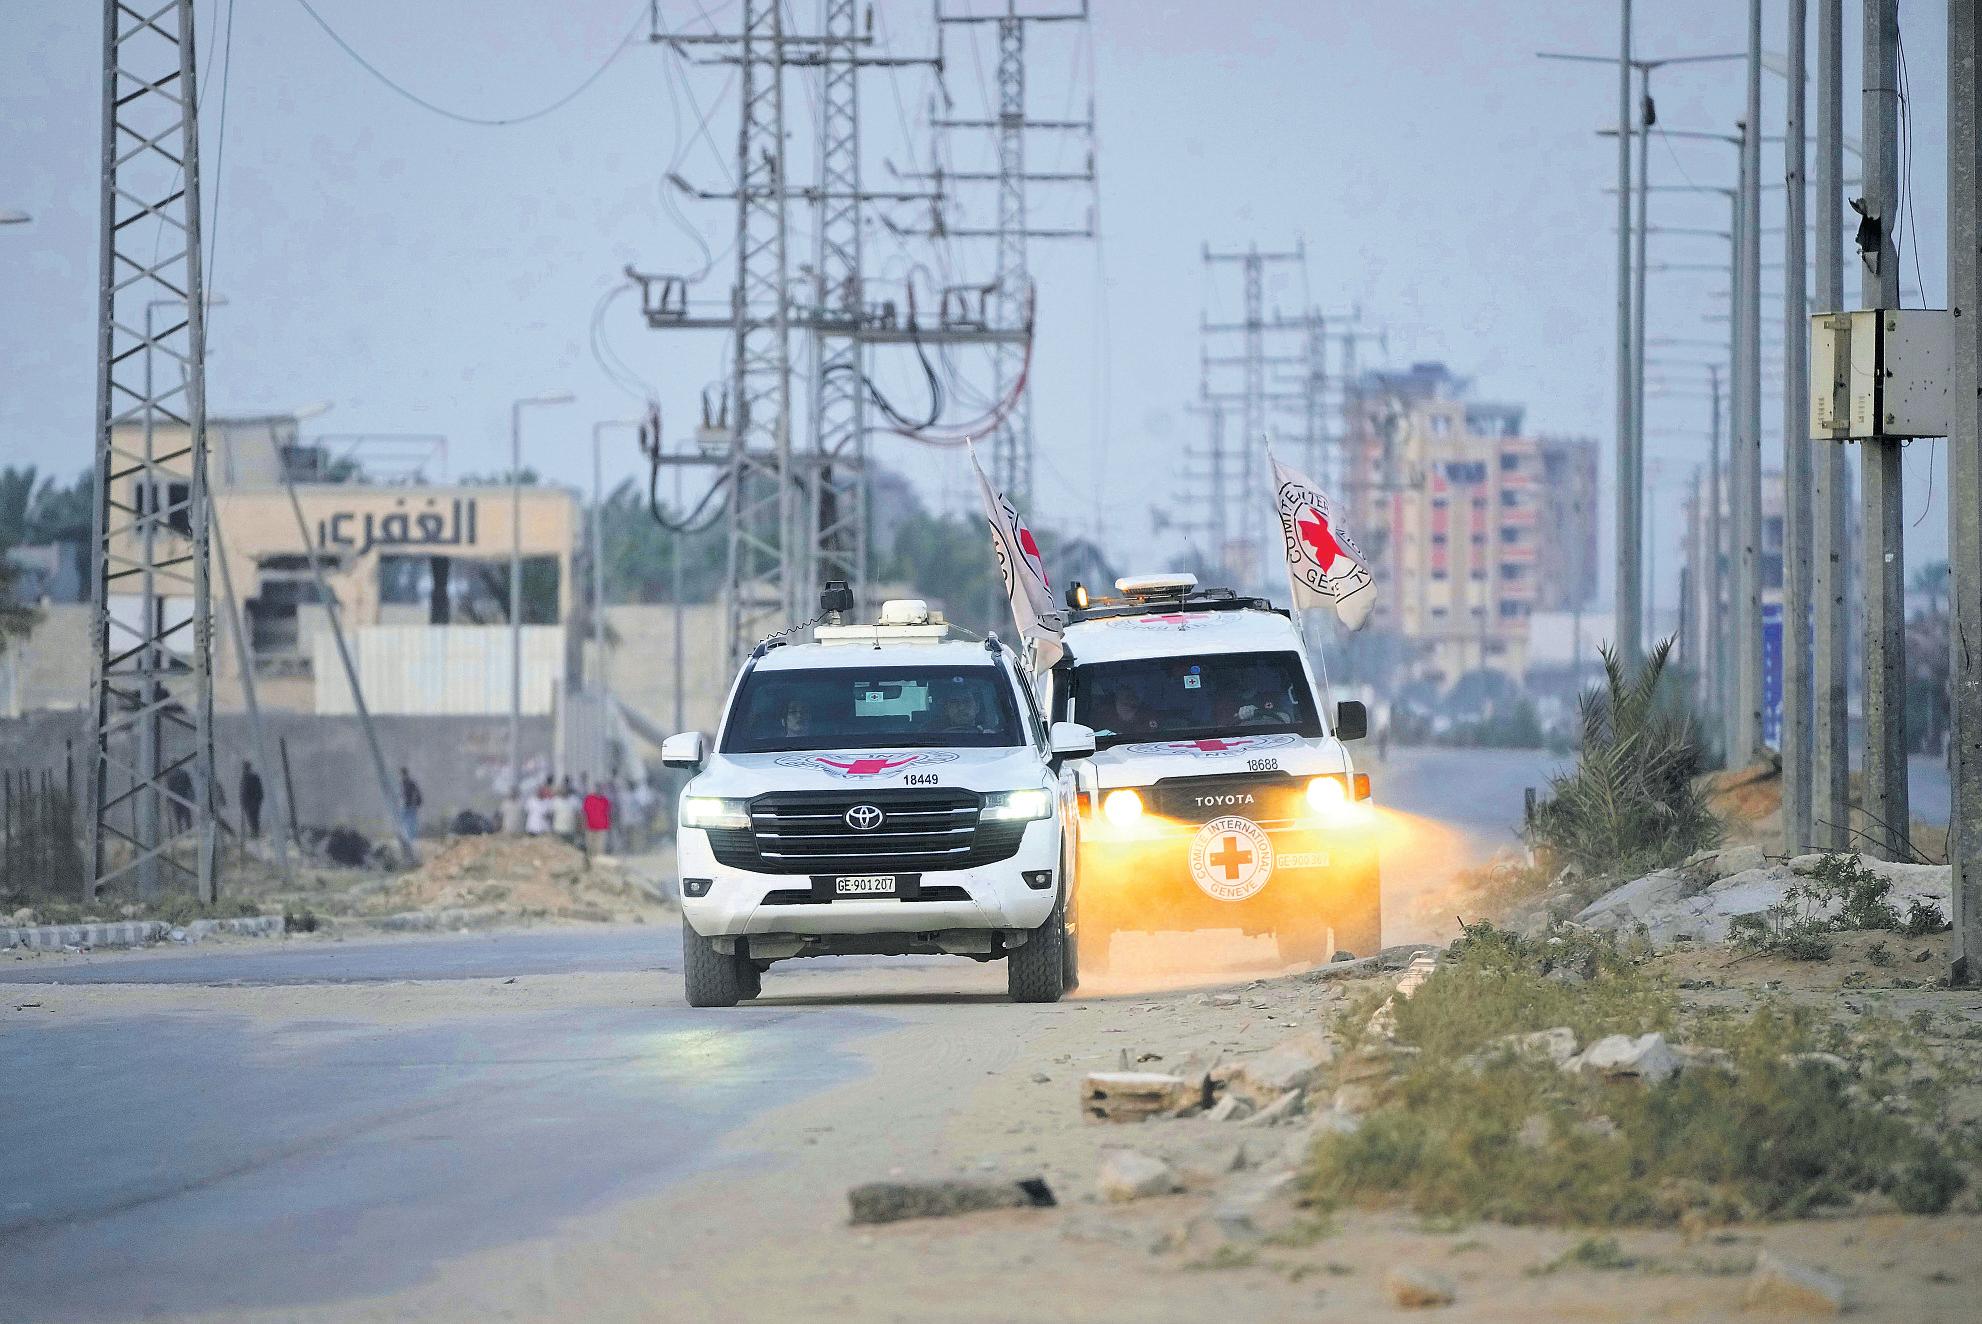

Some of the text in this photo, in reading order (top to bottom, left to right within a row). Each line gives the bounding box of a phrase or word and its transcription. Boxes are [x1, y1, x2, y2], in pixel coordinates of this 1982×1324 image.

[1246, 758, 1278, 771] 18688
[903, 773, 938, 786] 18449
[1195, 794, 1255, 807] TOYOTA
[1207, 819, 1271, 874] INTERNATIONAL
